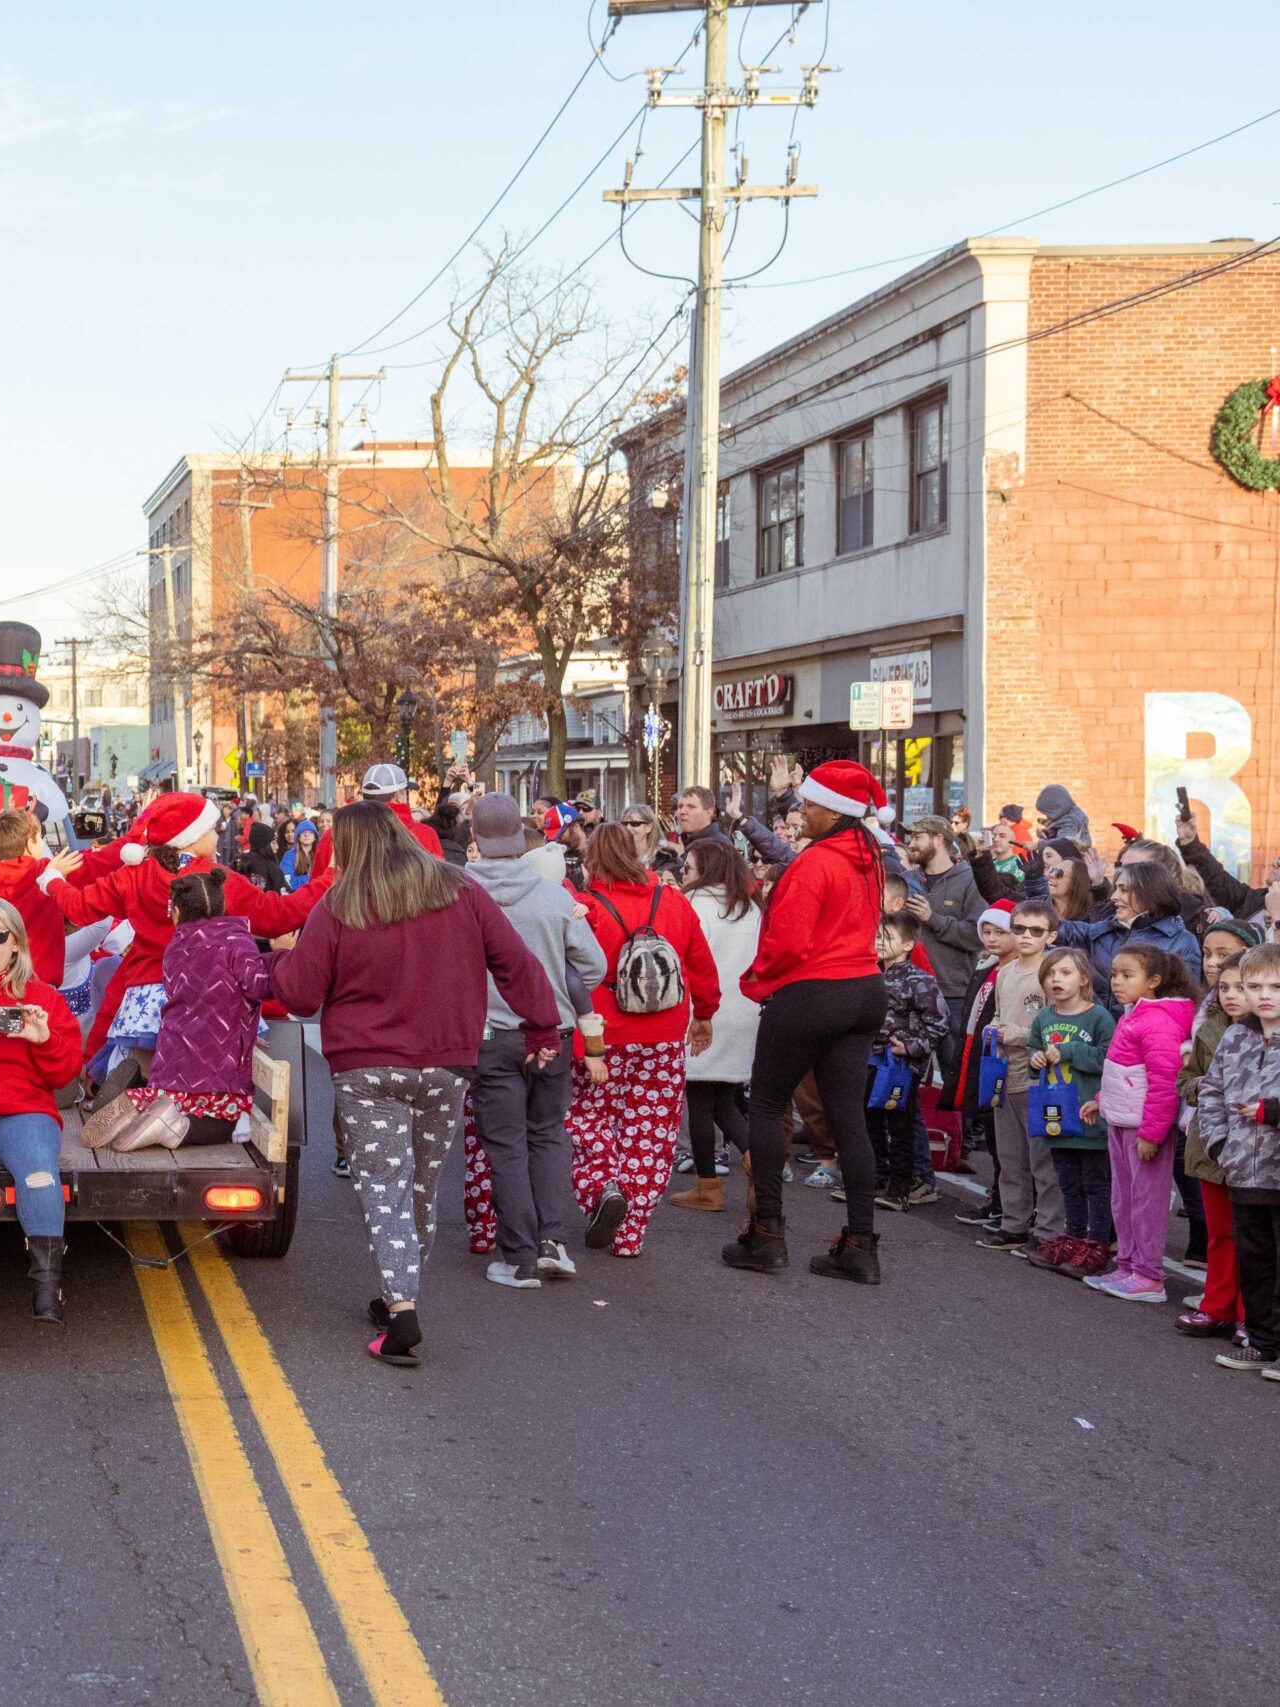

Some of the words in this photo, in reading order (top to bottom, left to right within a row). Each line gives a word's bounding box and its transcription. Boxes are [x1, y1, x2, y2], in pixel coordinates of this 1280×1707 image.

[714, 673, 780, 711] CRAFT'D
[891, 687, 903, 695] NO
[1079, 1029, 1093, 1042] UP
